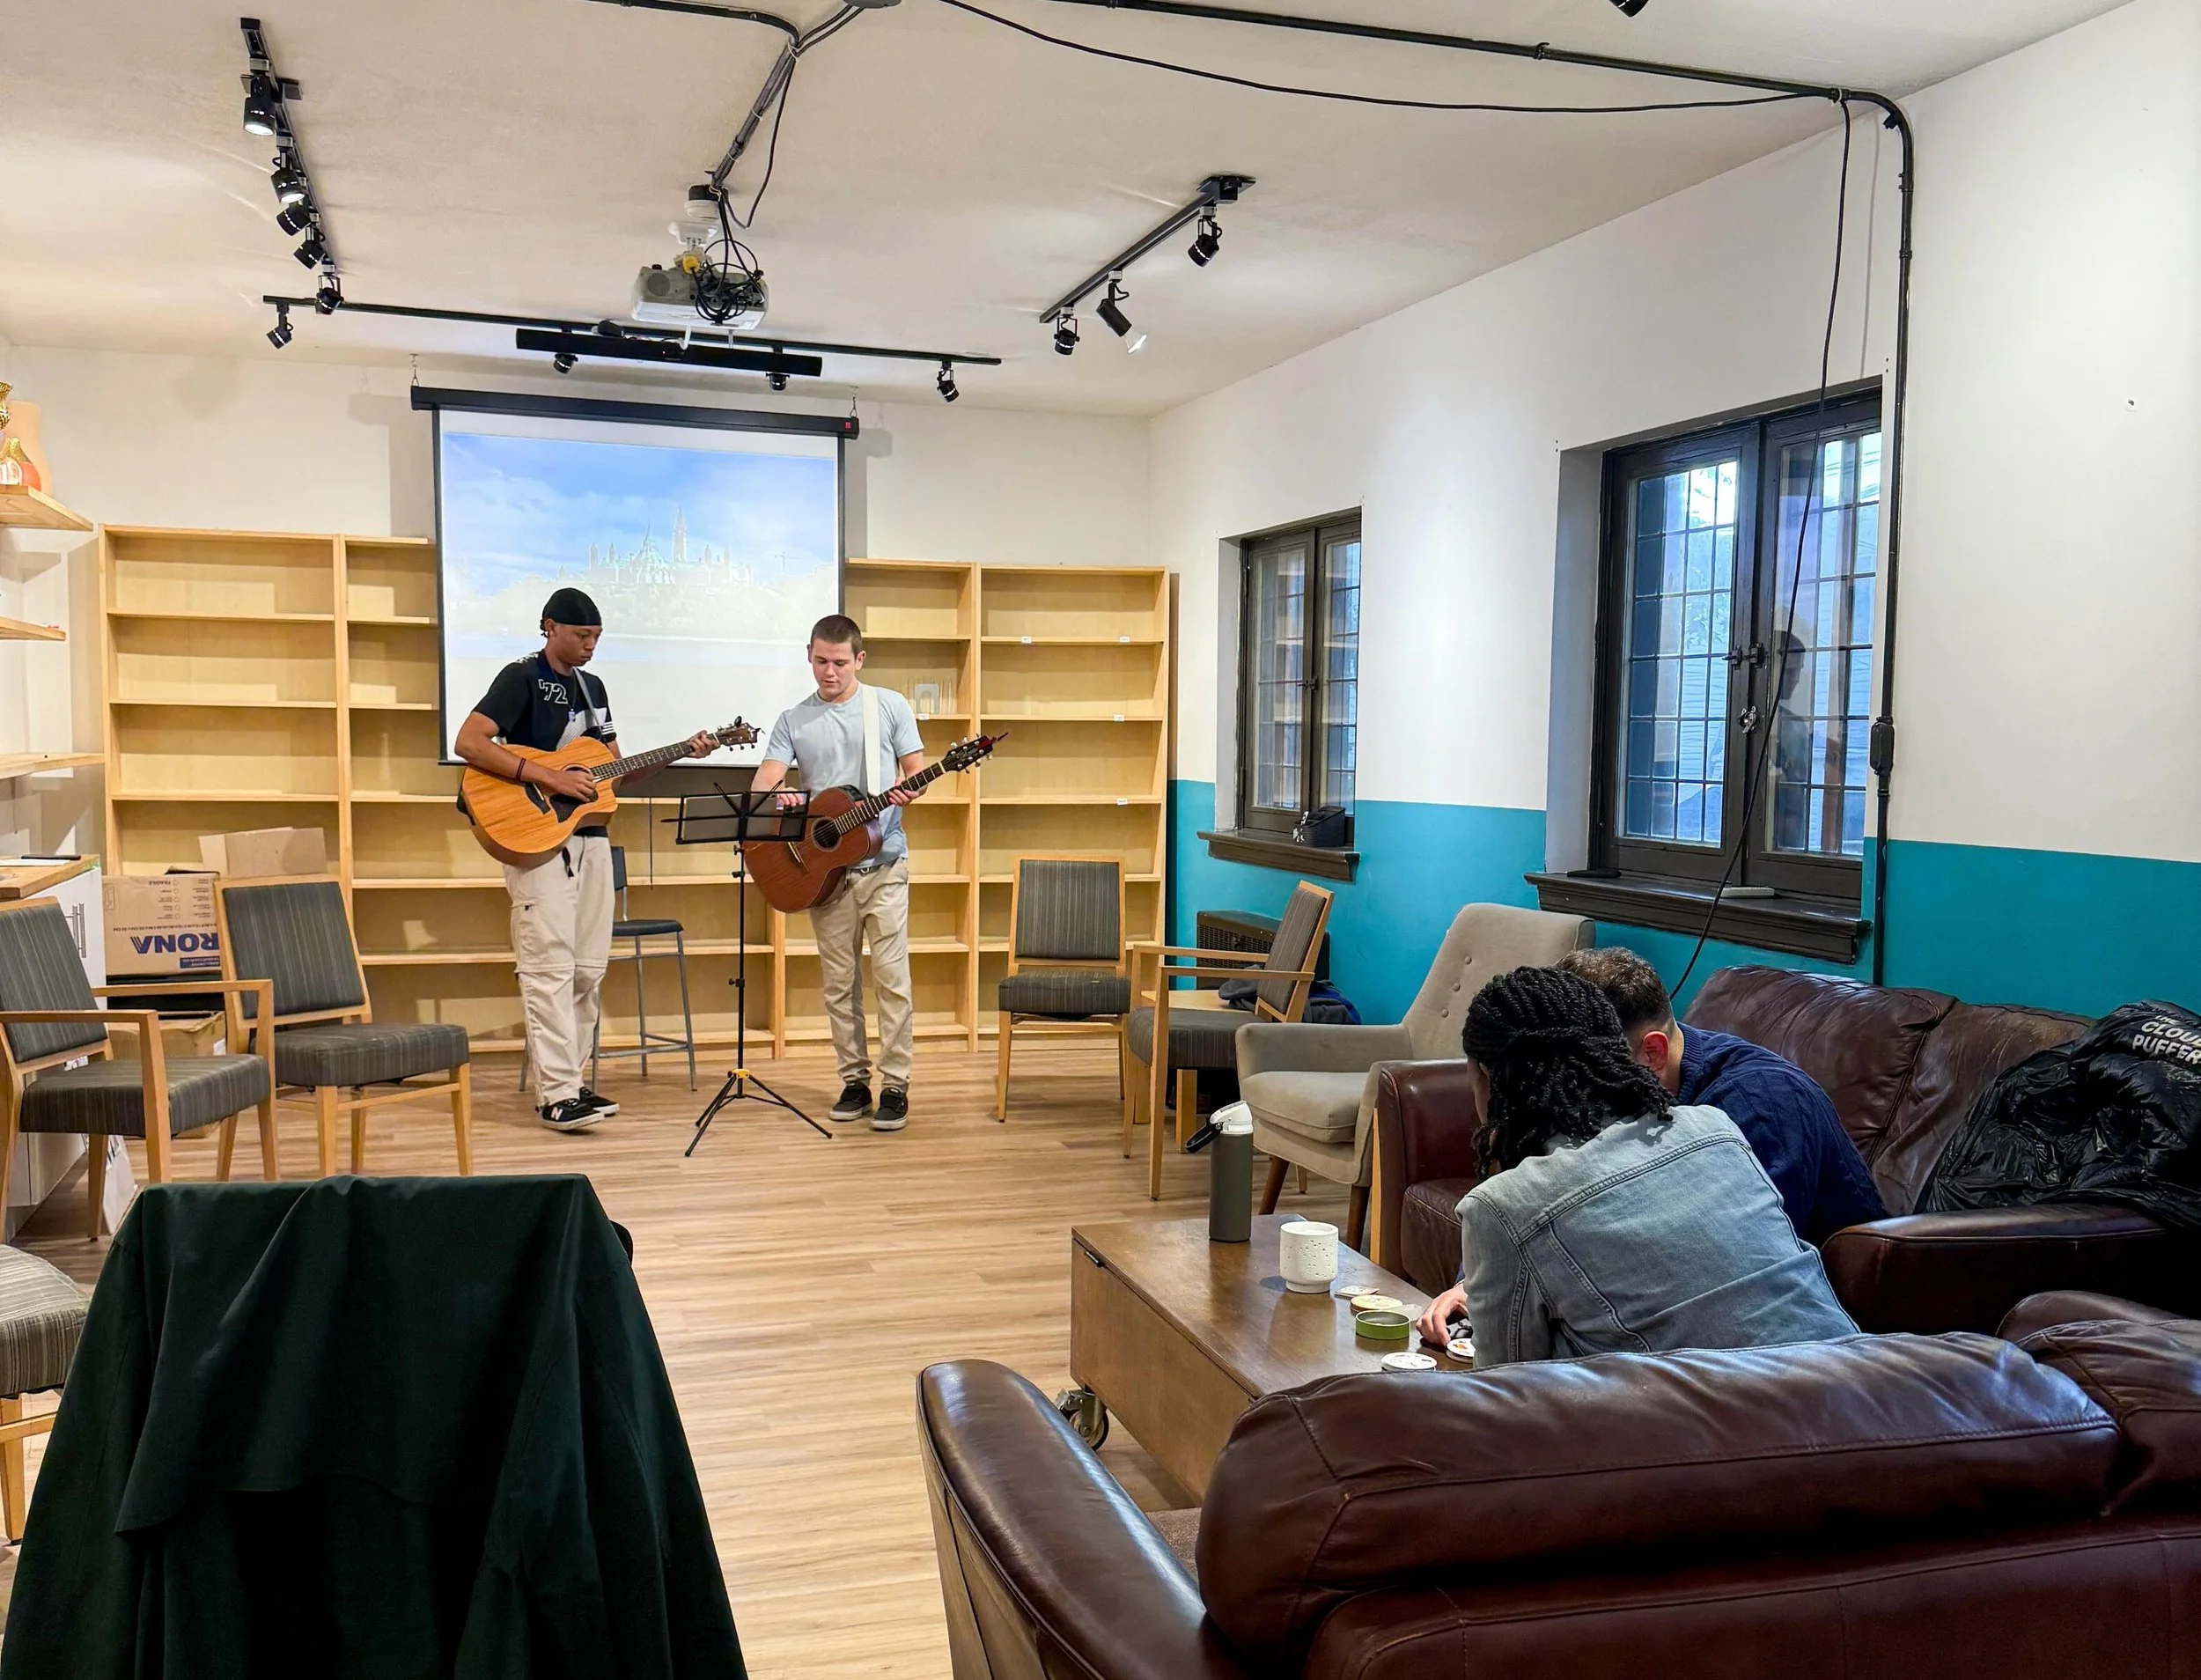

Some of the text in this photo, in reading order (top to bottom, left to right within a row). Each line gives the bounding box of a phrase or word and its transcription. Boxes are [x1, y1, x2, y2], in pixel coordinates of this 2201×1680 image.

[130, 932, 220, 954] RONA
[2132, 1034, 2201, 1065] PUFFER
[550, 1106, 563, 1121] N
